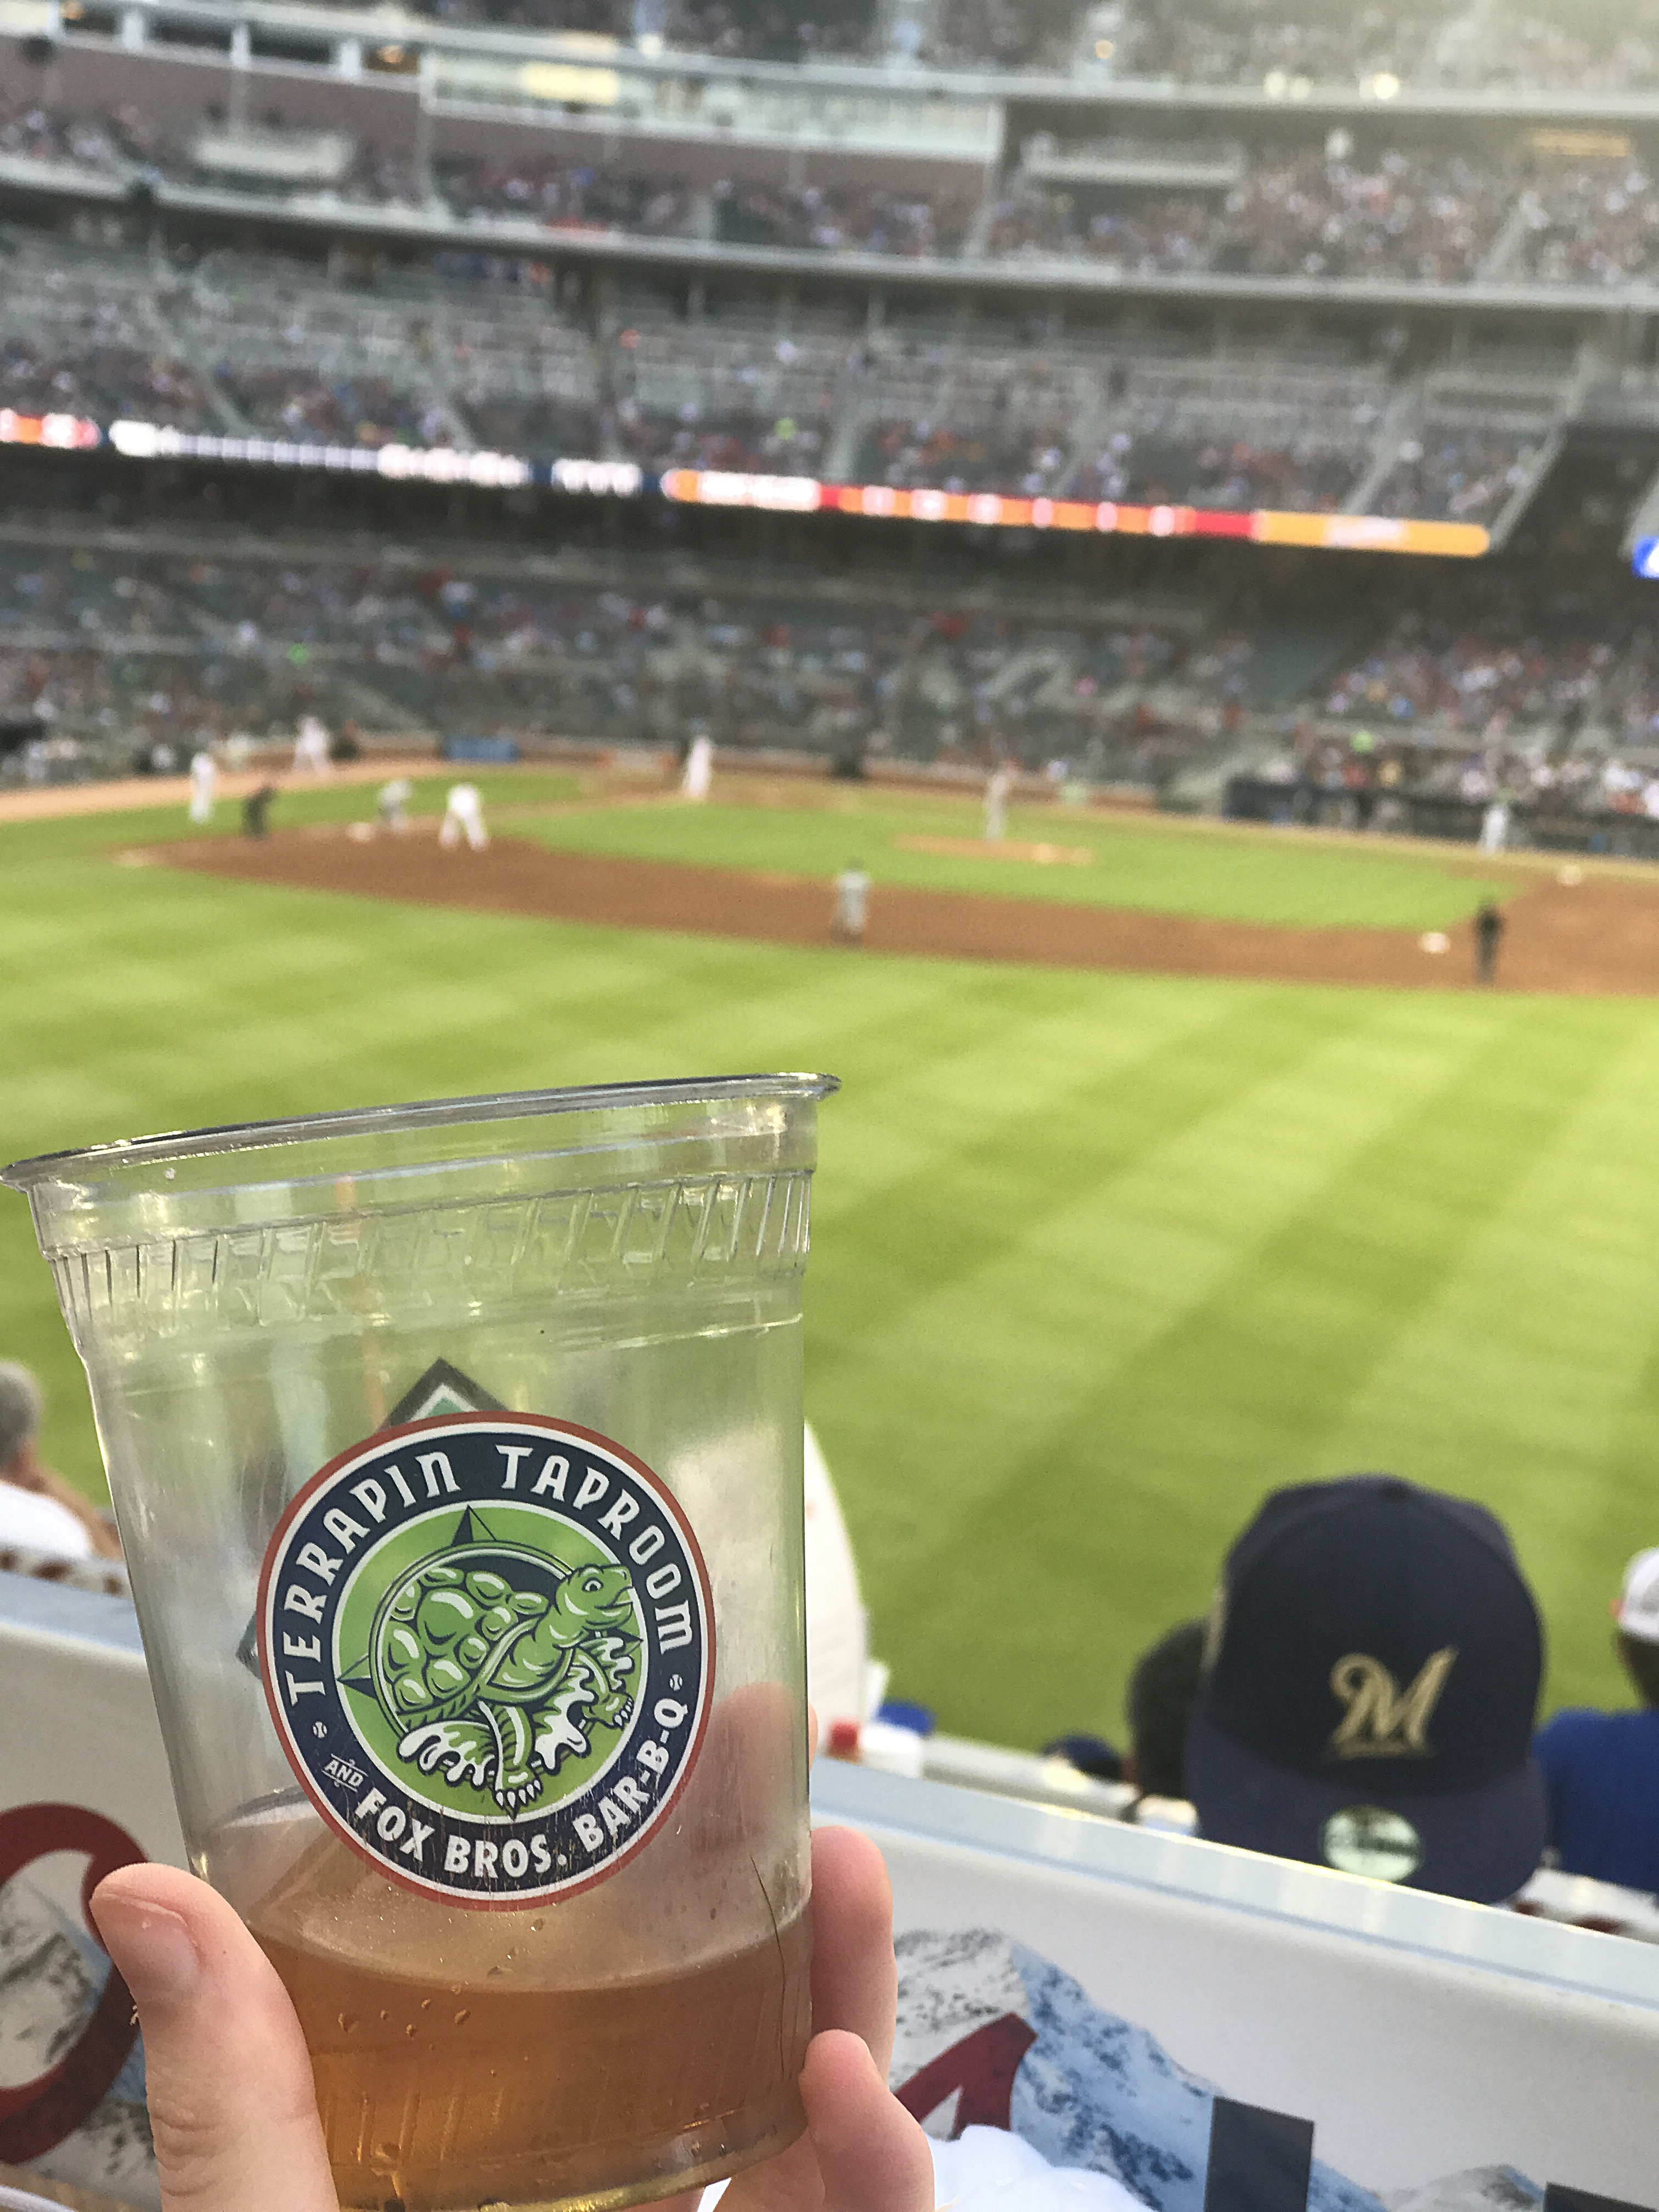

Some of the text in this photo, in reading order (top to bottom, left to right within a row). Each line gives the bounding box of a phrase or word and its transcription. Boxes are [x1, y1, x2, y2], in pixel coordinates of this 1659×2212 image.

[283, 1445, 693, 1706] TERRAPIN TAPROOM
[325, 1759, 364, 1788] AND
[1328, 1647, 1458, 1758] M
[357, 1700, 689, 1879] FOX BROS. BAR-B-Q
